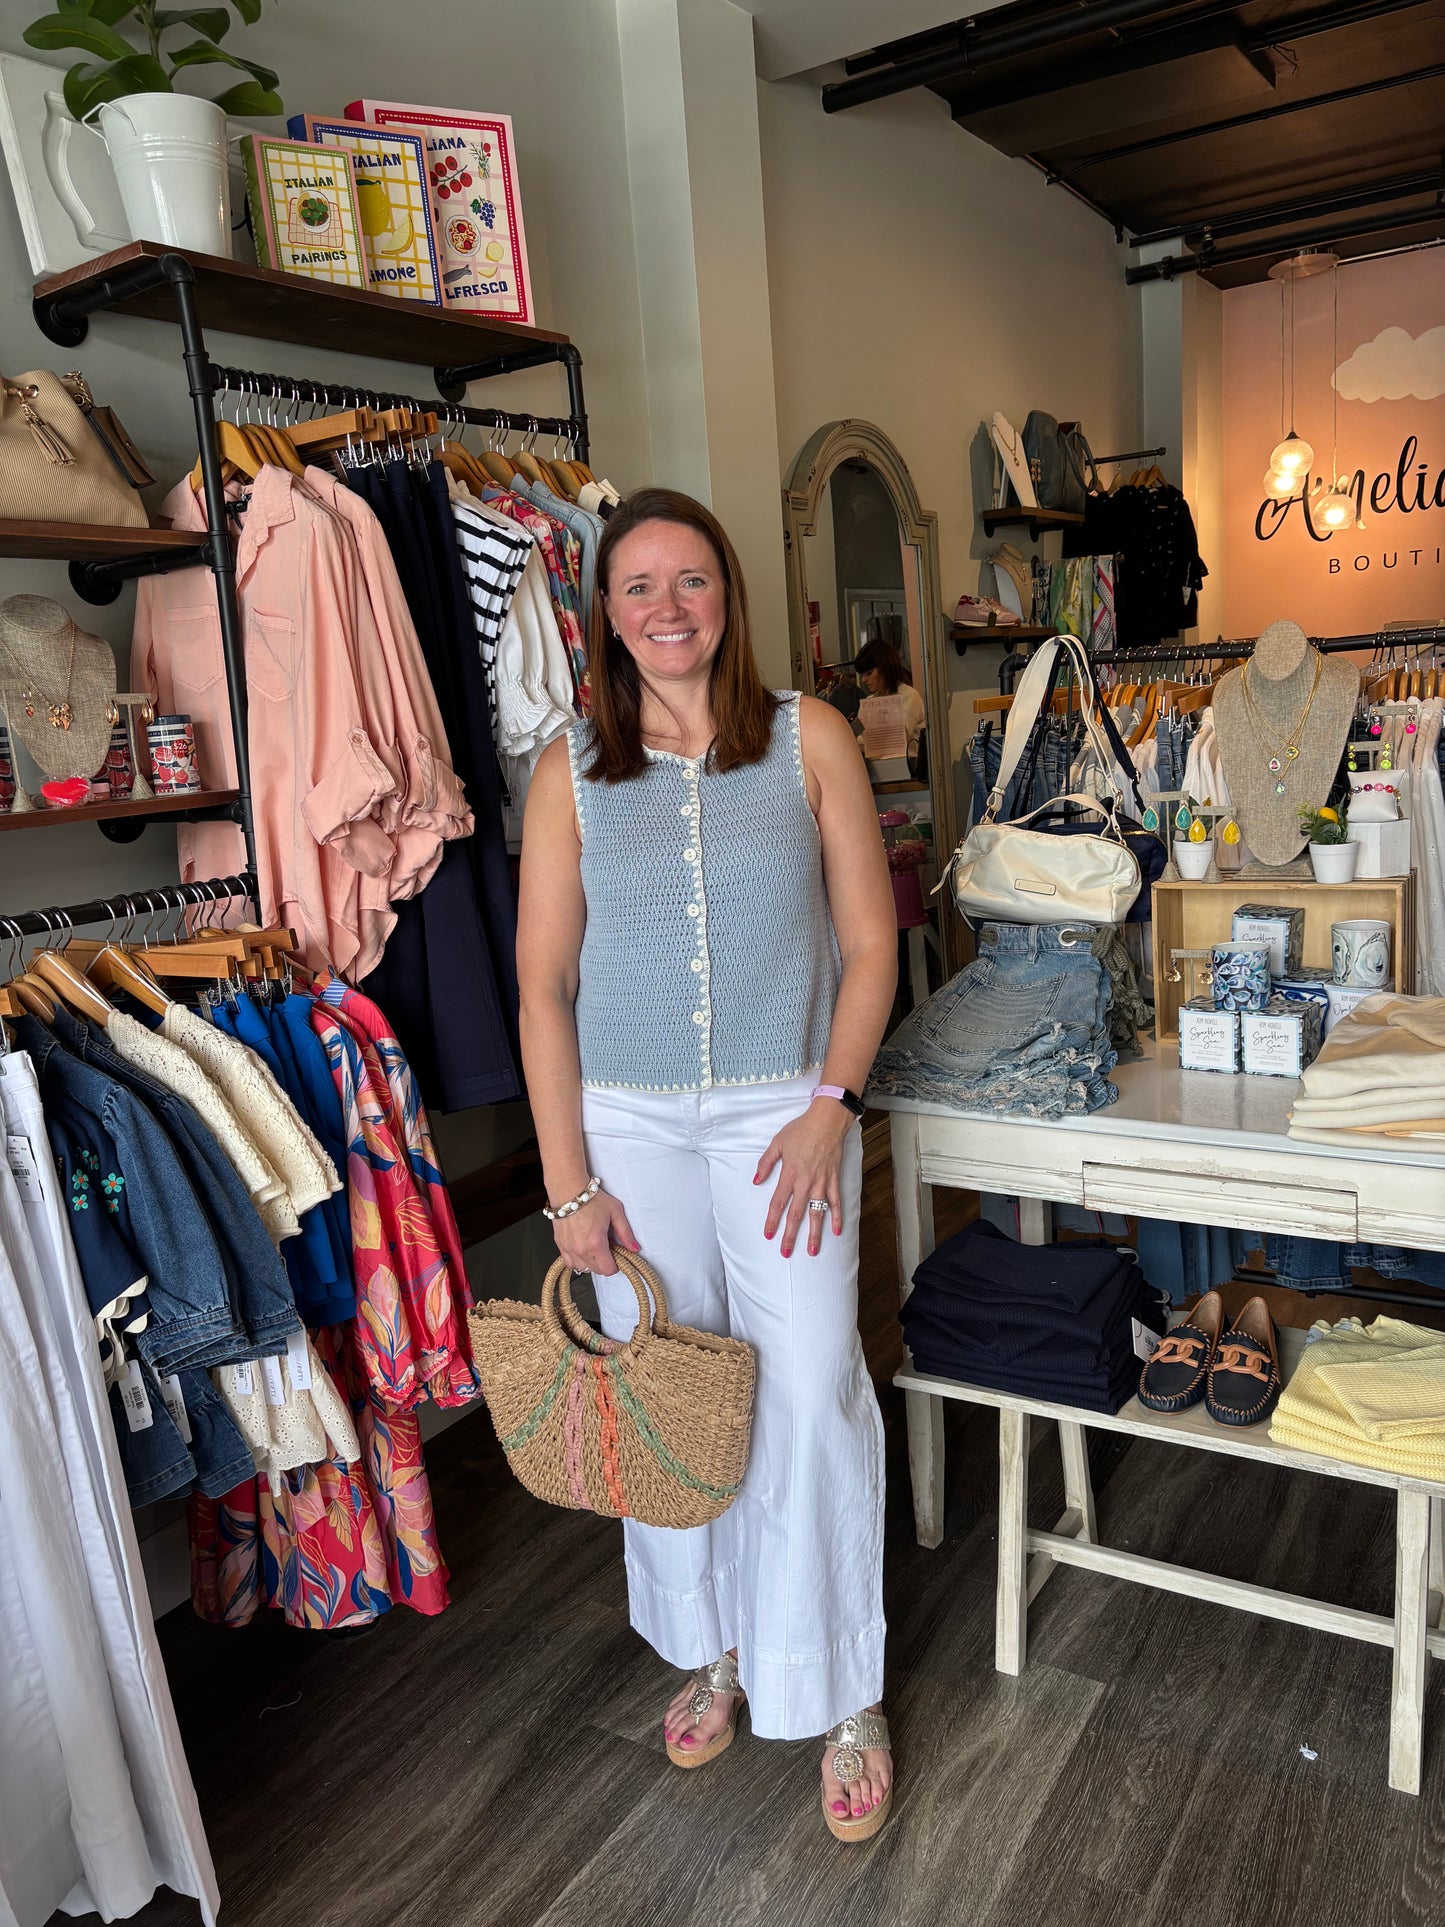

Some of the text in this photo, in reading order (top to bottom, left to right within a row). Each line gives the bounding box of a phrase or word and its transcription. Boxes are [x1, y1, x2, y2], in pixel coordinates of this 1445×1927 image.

[369, 266, 416, 283] iMONe
[1329, 547, 1440, 574] BOUTI
[173, 742, 188, 750] $26
